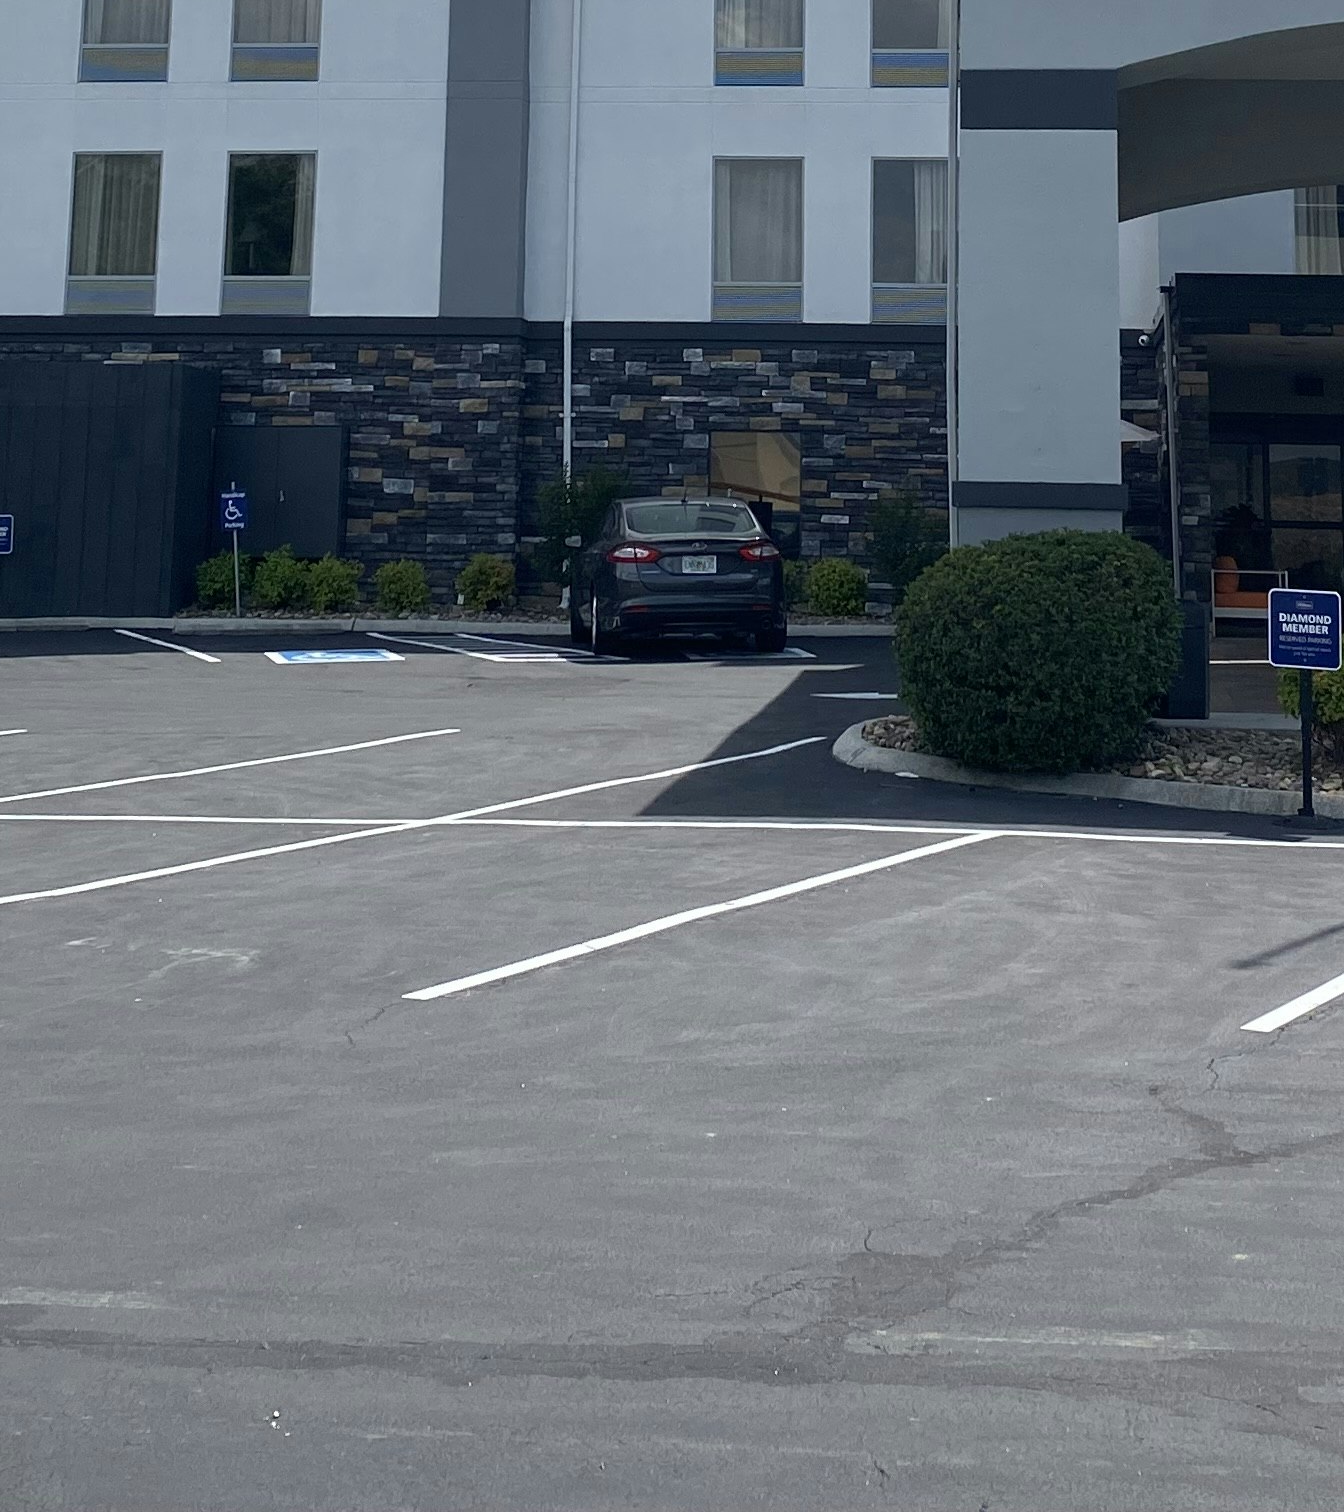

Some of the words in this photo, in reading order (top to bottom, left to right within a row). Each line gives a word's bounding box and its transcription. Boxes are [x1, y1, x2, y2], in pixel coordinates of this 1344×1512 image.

[1278, 612, 1332, 625] DIAMOND
[1282, 623, 1329, 635] MEMBER
[1279, 635, 1307, 643] RESERVED
